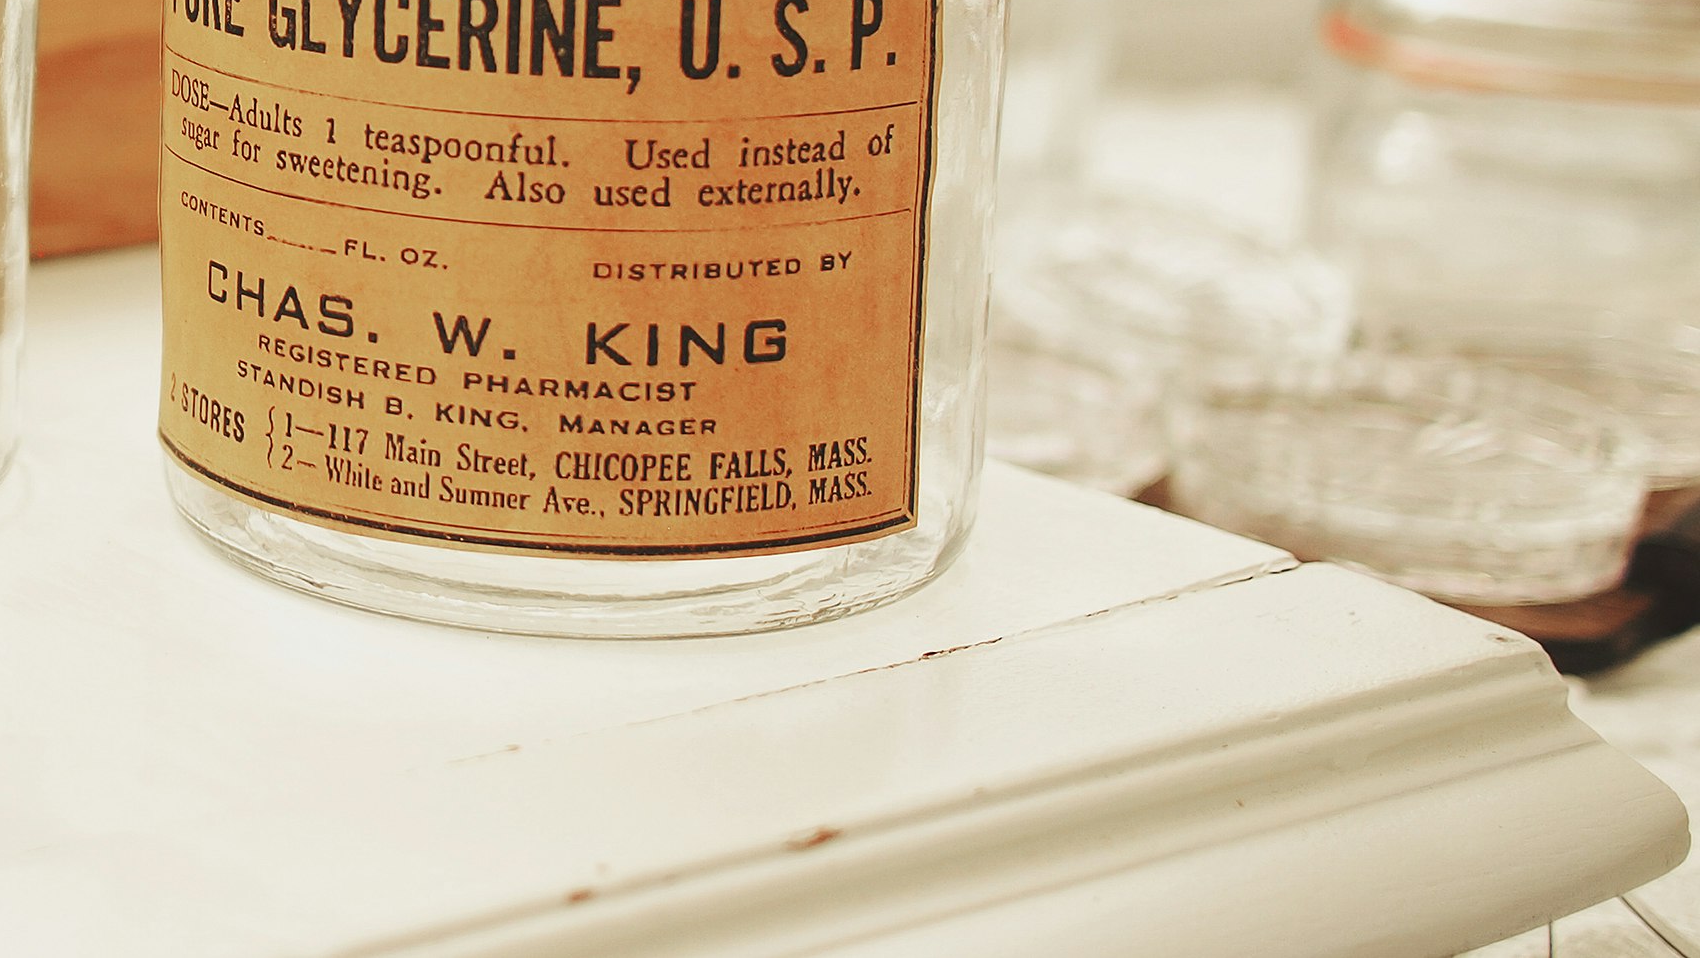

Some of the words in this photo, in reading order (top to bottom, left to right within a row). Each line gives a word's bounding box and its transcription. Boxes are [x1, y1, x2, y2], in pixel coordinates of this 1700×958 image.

[181, 117, 220, 150] sugar
[233, 129, 261, 163] for
[276, 149, 443, 200] sweetening.
[484, 169, 566, 205] Also
[594, 177, 671, 208] used
[698, 168, 861, 207] externally.
[326, 118, 336, 144] 1
[364, 123, 570, 168] teaspoonful.
[625, 138, 711, 170] Used
[738, 130, 846, 168] instead
[867, 124, 895, 157] of
[343, 239, 387, 262] FL.
[400, 248, 449, 270] OZ.
[593, 258, 801, 282] DISTRIBUTED
[820, 251, 853, 273] BY
[207, 259, 379, 344] CHAS.
[432, 311, 517, 360] W.
[585, 318, 788, 367] KING
[237, 359, 366, 410] STANDISH
[558, 415, 718, 437] MANAGER
[258, 334, 437, 386] REGISTERED
[463, 371, 698, 402] PHARMACIST
[181, 382, 246, 444] STORES
[385, 432, 443, 468] Main
[457, 443, 537, 481] Street,
[555, 450, 692, 482] CHICOPEE
[709, 448, 793, 480] FALLS,
[807, 436, 873, 472] MASS.
[390, 472, 431, 500] and
[438, 477, 532, 512] Sumner
[618, 481, 797, 517] SPRINGFIELD,
[808, 471, 873, 505] MASS.
